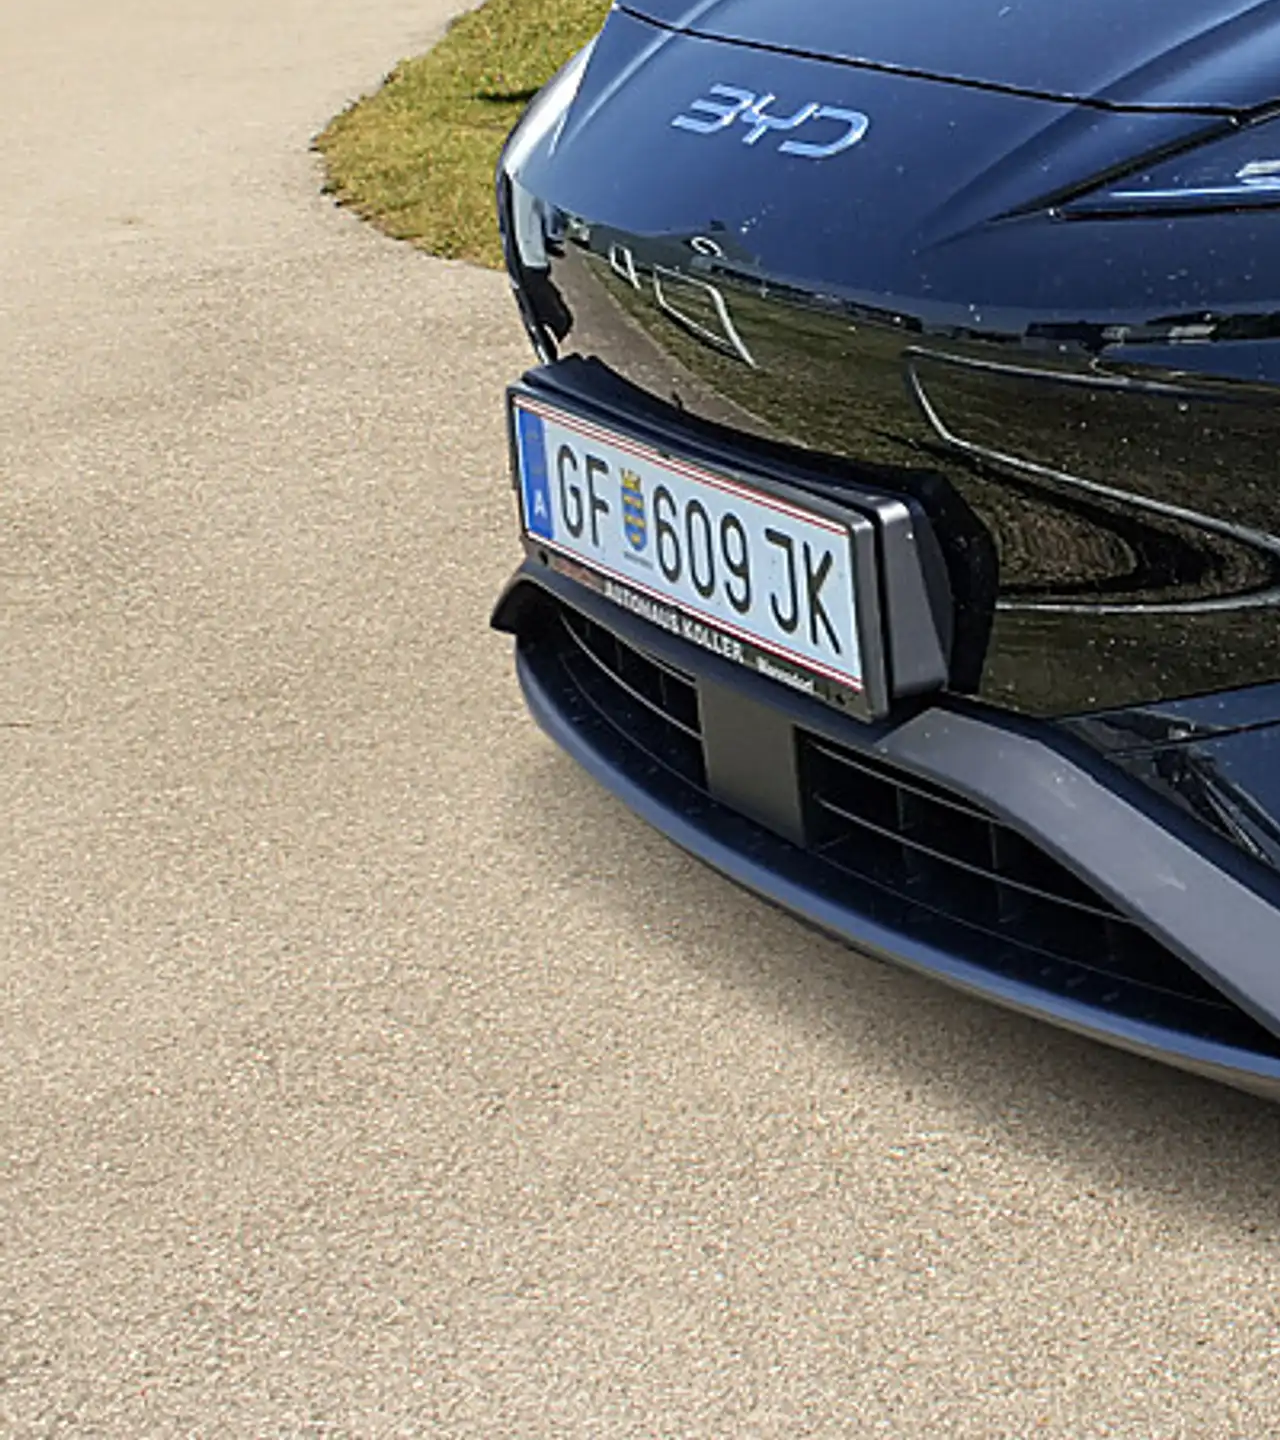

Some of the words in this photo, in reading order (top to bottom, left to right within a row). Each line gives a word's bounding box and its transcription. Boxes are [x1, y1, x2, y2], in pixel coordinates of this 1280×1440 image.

[672, 83, 870, 159] BYD
[533, 490, 548, 519] A
[557, 443, 609, 547] GF
[652, 484, 752, 615] 609
[764, 528, 842, 655] JK
